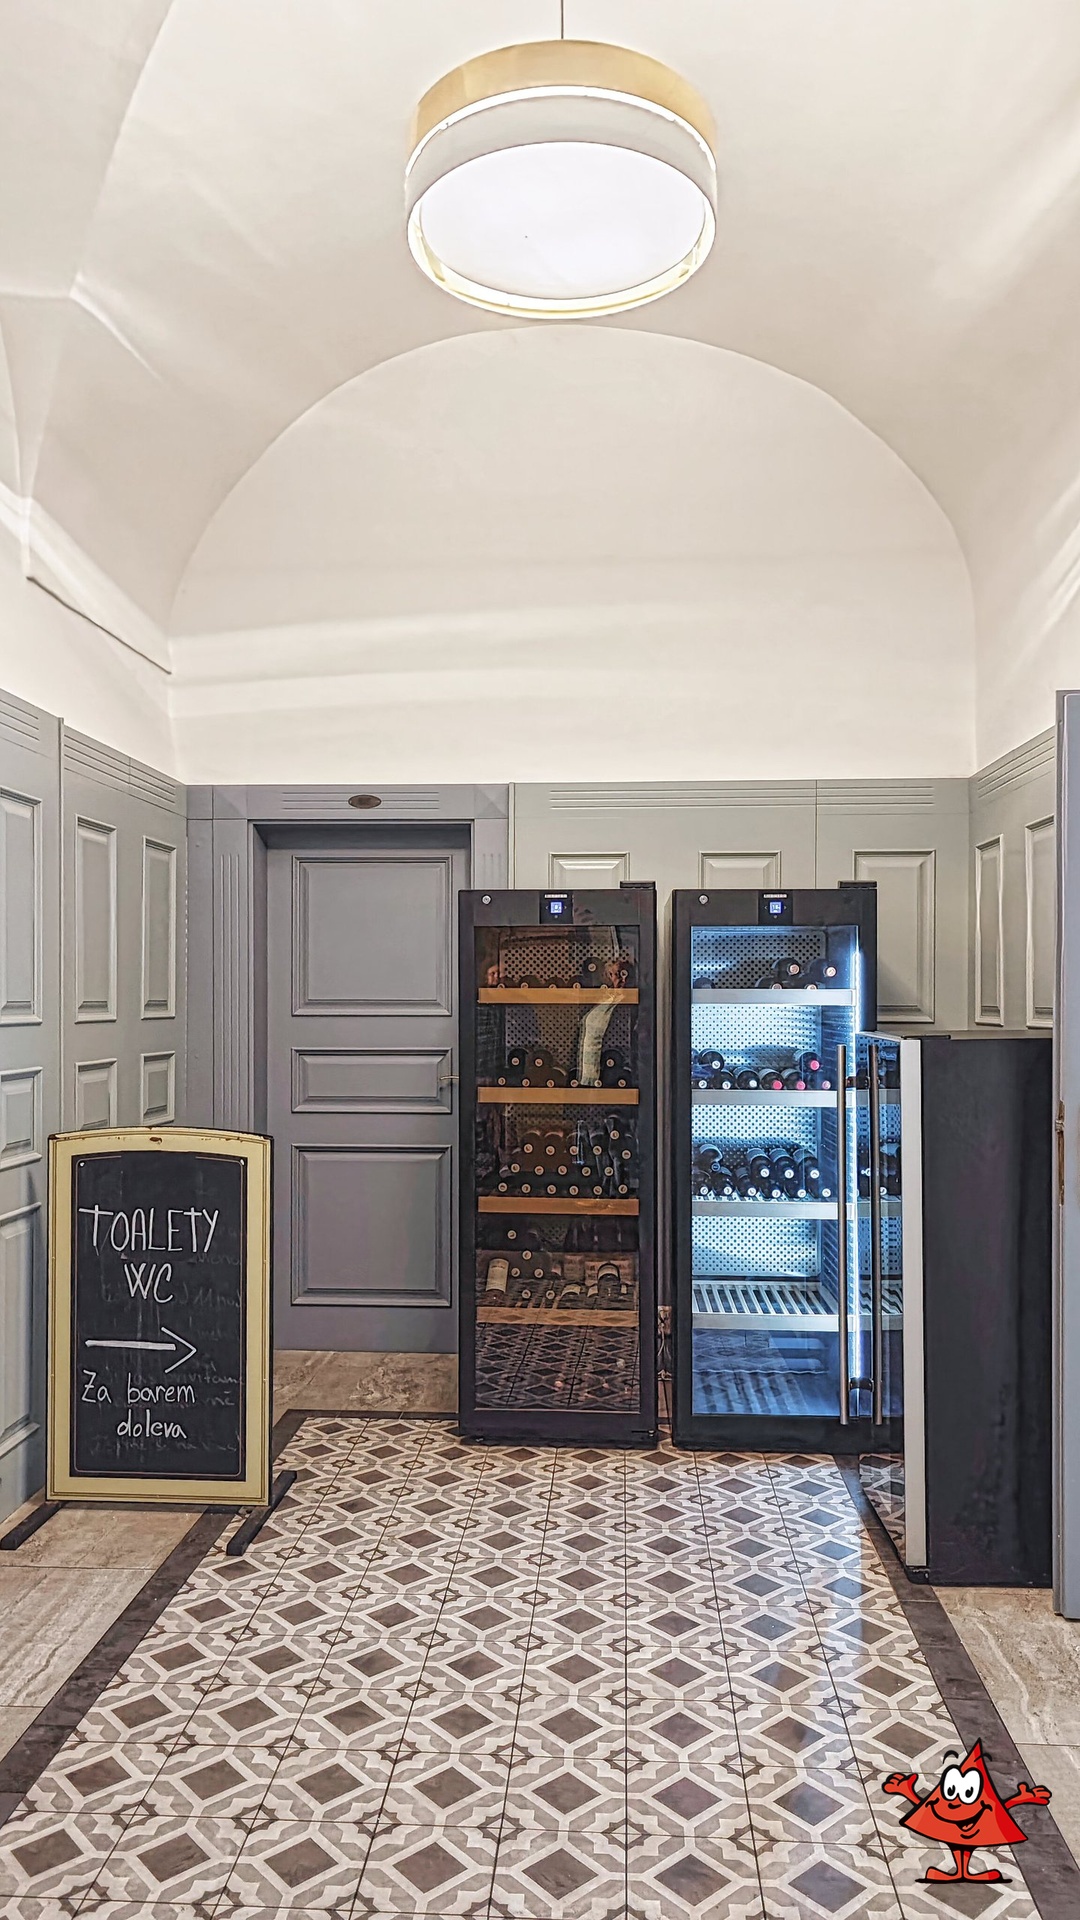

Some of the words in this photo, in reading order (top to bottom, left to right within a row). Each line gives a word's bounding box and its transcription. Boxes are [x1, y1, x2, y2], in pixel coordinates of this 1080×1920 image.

[78, 1204, 220, 1254] TOALETY
[123, 1262, 174, 1304] WC
[81, 1369, 112, 1404] Za
[127, 1371, 196, 1404] barem
[116, 1408, 187, 1440] doleva
